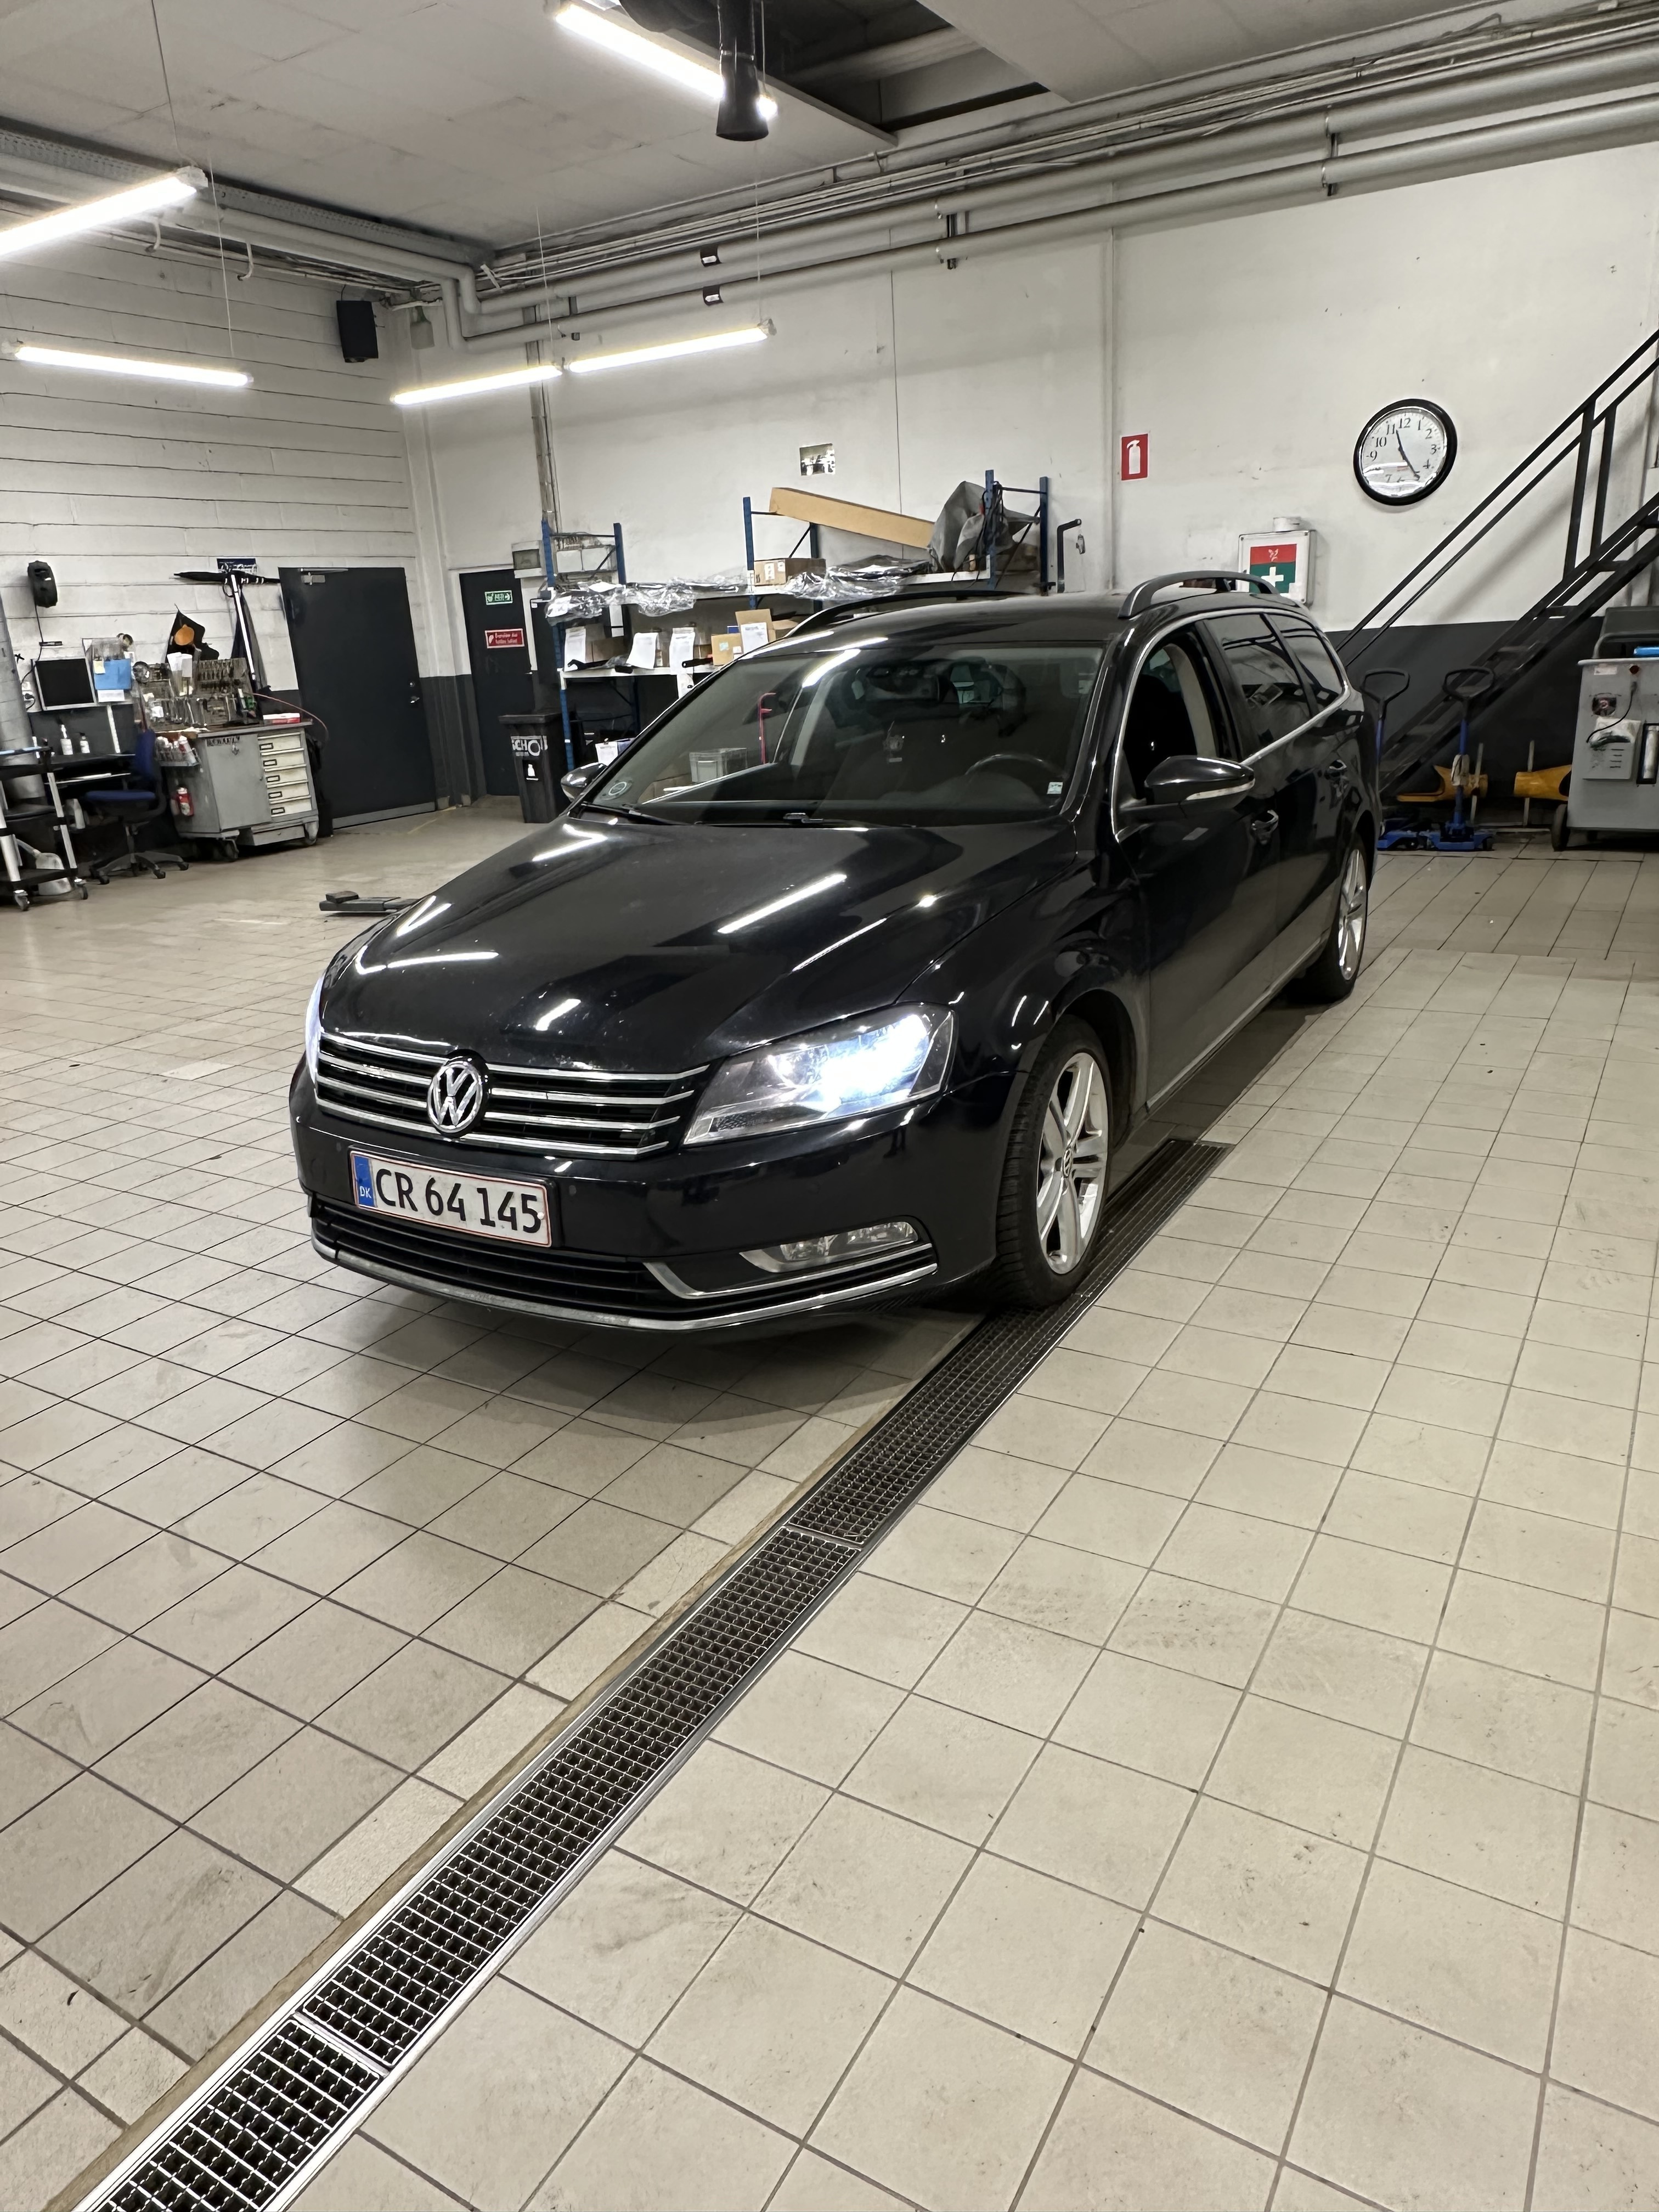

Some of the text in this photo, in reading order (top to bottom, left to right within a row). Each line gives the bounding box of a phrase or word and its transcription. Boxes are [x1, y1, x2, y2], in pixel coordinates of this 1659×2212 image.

[1398, 417, 1411, 428] 12
[1418, 419, 1421, 431] 1
[1386, 424, 1395, 435] 11
[1425, 428, 1432, 439] 2
[1375, 437, 1387, 447] 10
[1431, 444, 1437, 454] 3
[1370, 450, 1378, 461] 9
[1423, 459, 1431, 469] 4
[1385, 474, 1392, 483] 7
[430, 1063, 481, 1130] VW
[359, 1186, 372, 1199] DK
[376, 1168, 541, 1233] CR 64 145
